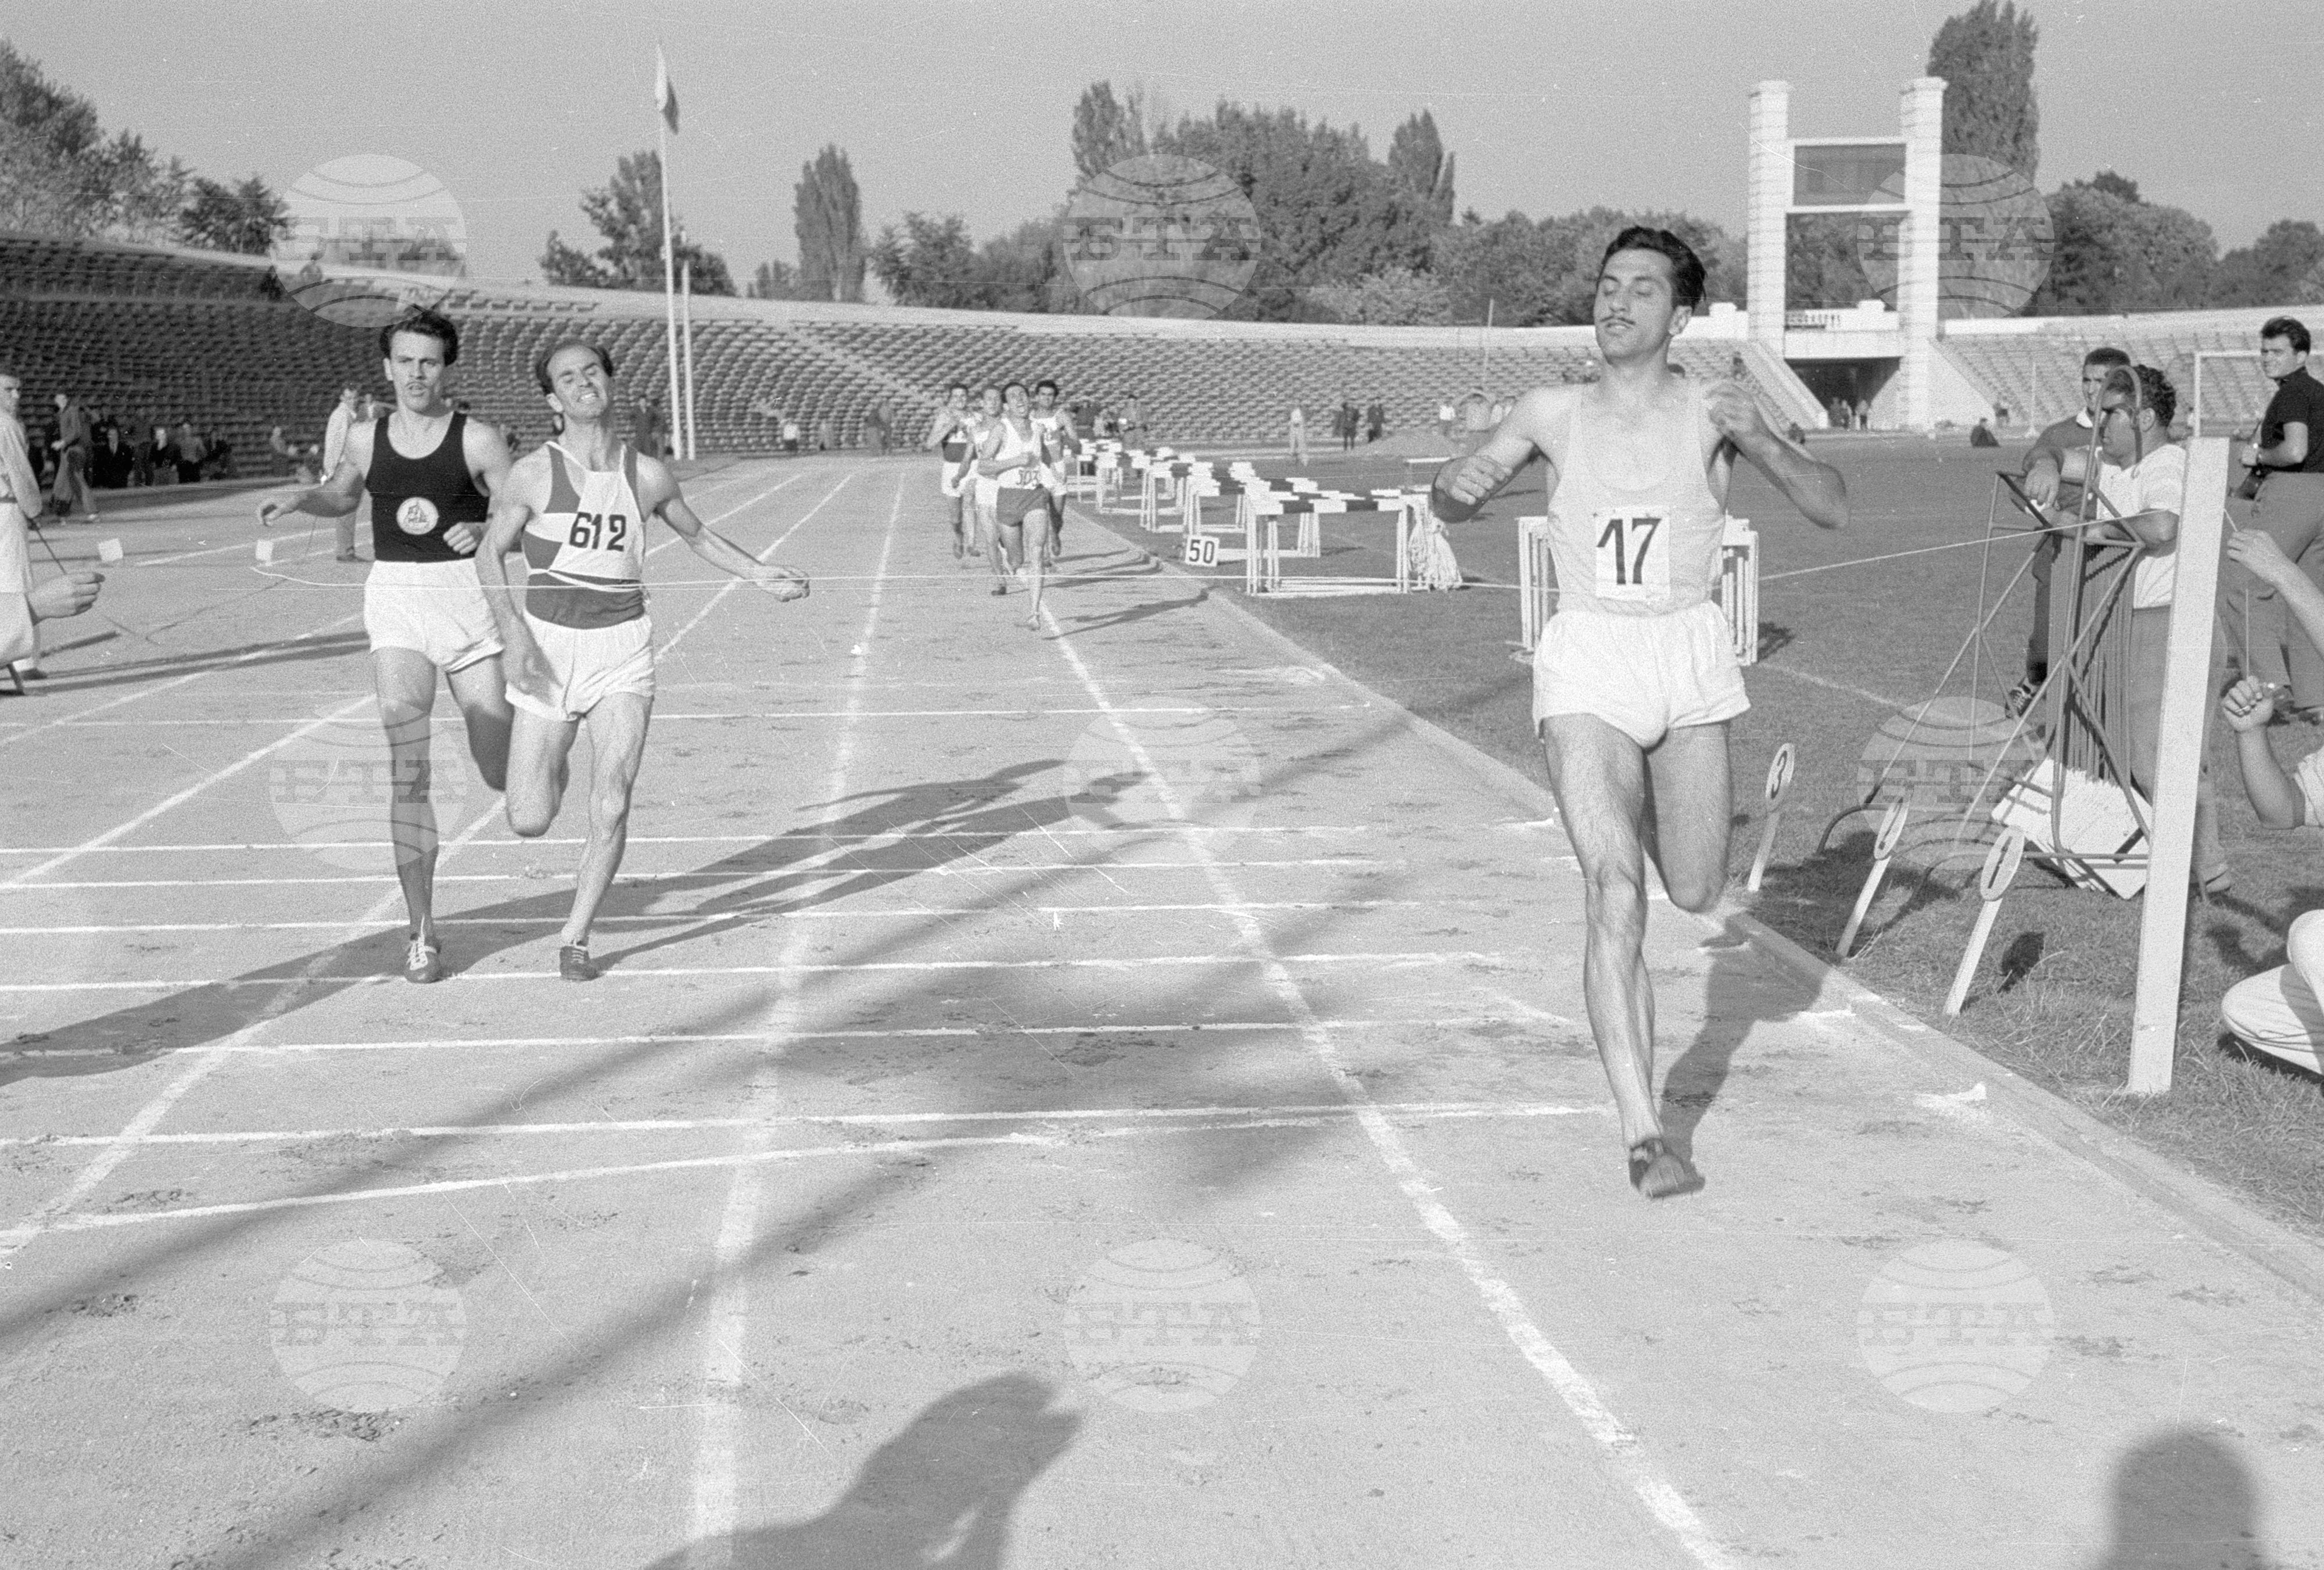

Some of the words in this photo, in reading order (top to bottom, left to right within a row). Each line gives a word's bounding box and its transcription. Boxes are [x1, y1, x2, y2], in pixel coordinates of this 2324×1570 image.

[569, 512, 626, 552] 612
[1189, 539, 1214, 564] 50
[1596, 517, 1662, 585] 17
[1771, 750, 1787, 800] 3
